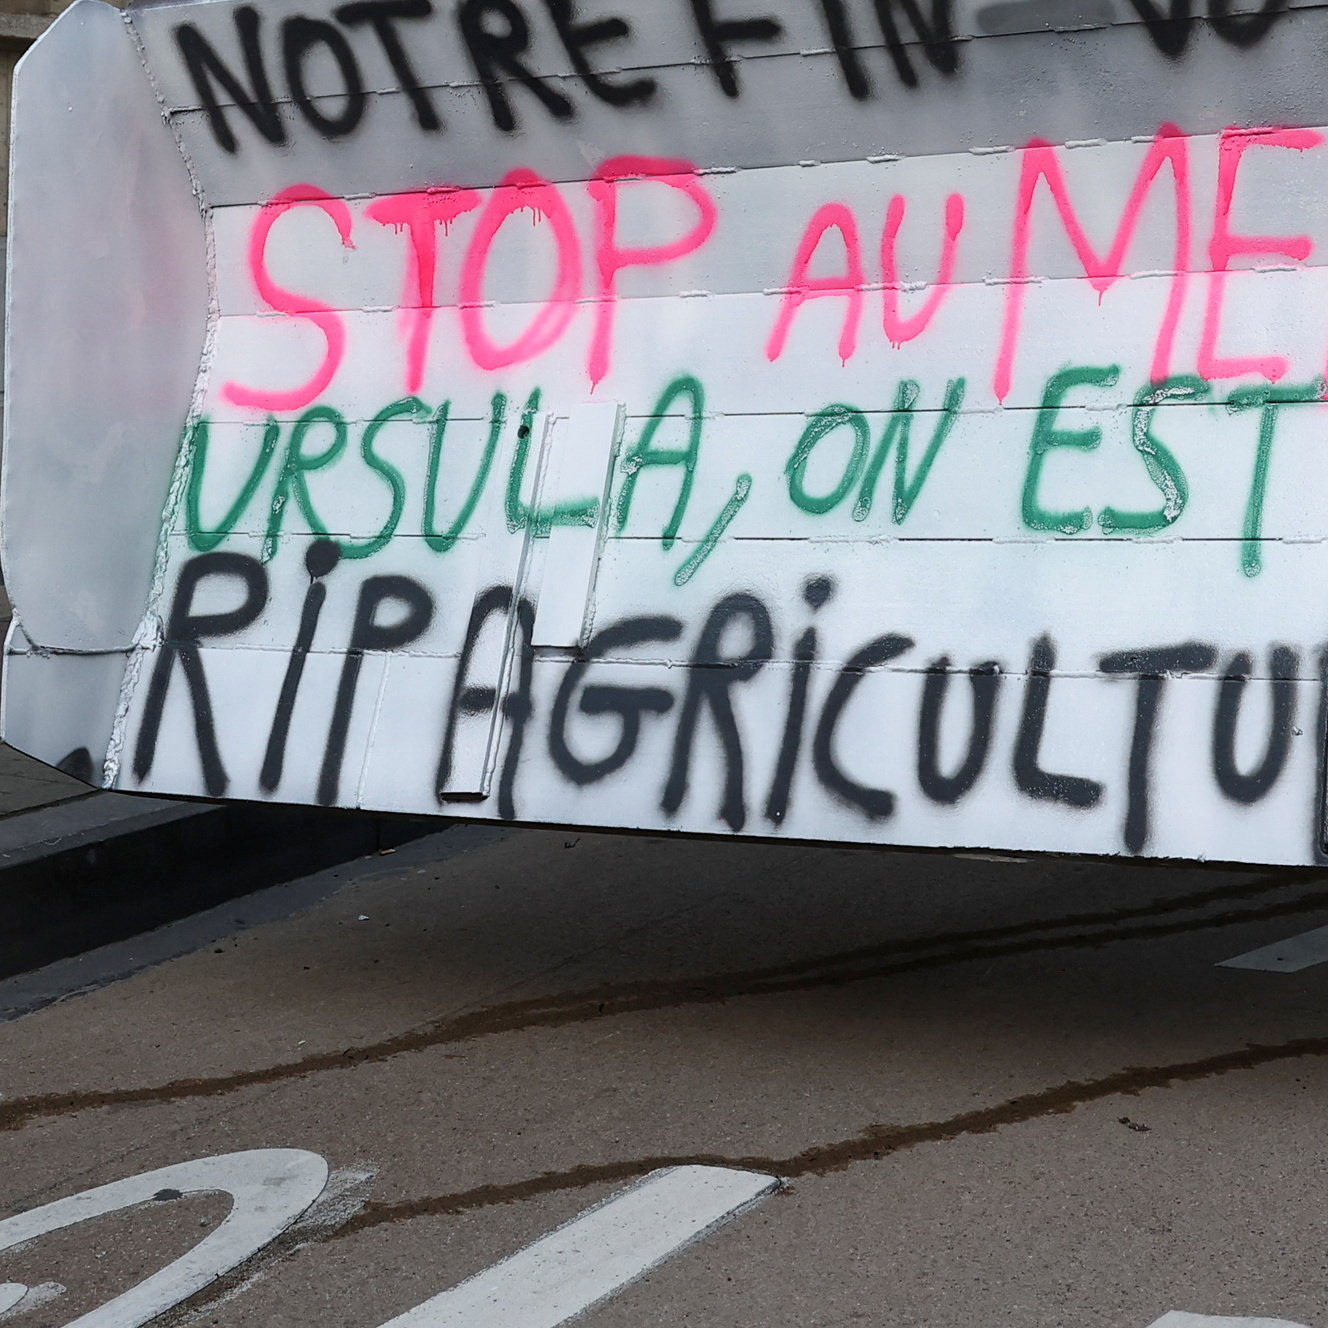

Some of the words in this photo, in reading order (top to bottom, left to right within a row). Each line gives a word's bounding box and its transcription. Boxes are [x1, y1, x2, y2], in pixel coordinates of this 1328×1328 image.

[220, 154, 718, 414] STOP
[766, 190, 966, 367] AU
[182, 372, 754, 588] URSULA,
[786, 377, 968, 527] ON
